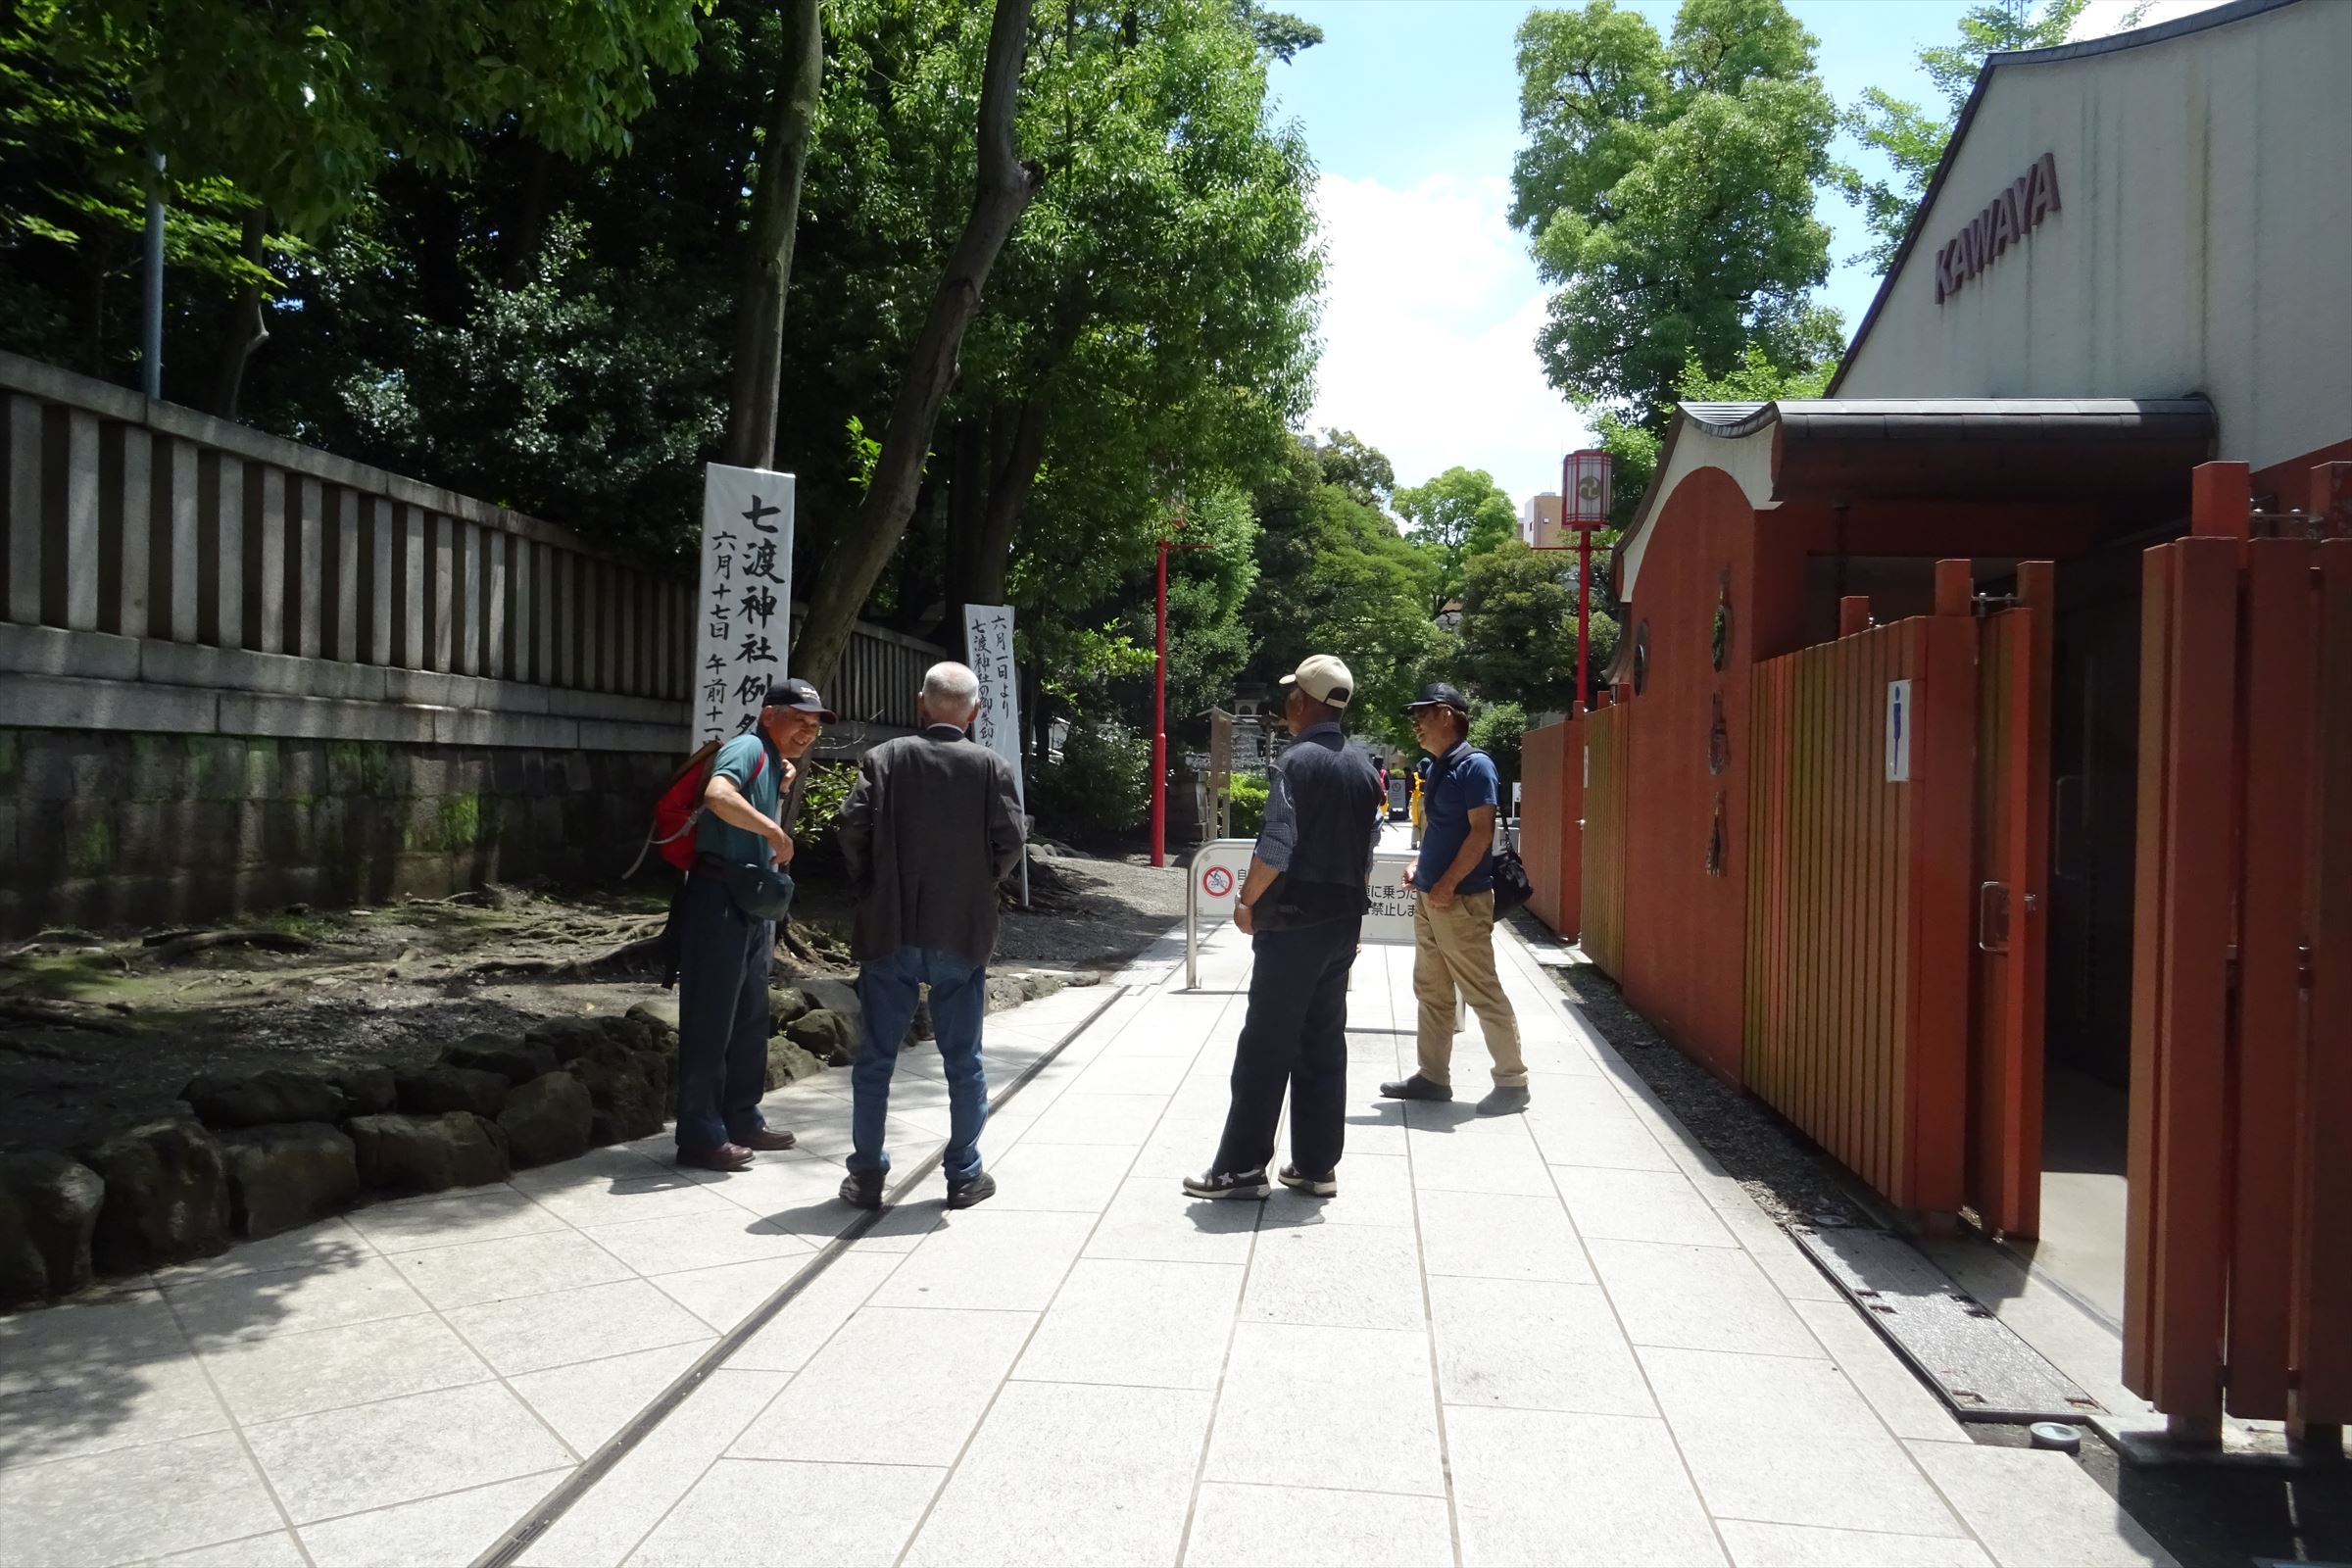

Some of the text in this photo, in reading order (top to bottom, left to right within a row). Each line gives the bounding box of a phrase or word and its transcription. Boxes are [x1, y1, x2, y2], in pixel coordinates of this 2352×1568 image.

[1935, 152, 2062, 305] KAWAYA
[704, 531, 737, 742] 六月十七日 午前十一
[991, 614, 1009, 719] 六月一日より
[1238, 868, 1250, 881] 自
